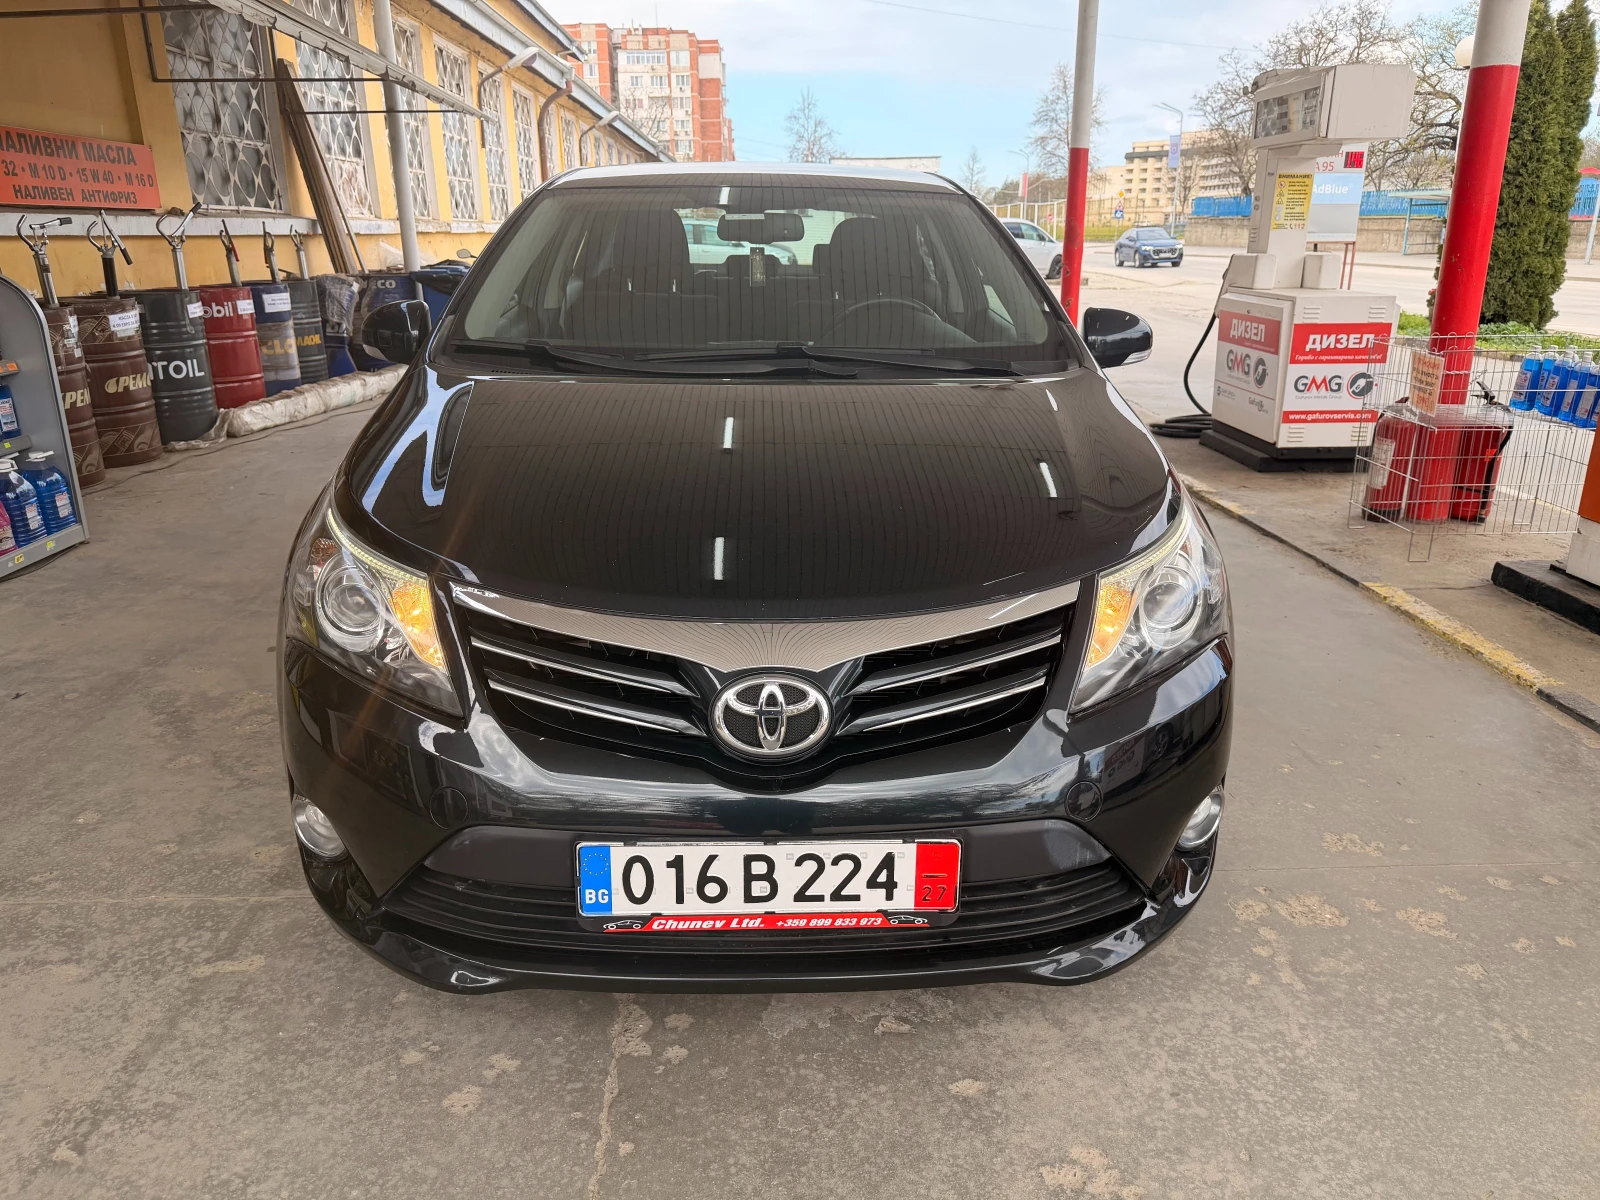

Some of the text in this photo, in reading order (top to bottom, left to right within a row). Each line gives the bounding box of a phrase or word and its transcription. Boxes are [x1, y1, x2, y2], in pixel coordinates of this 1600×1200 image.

[0, 130, 137, 166] АЛИВНИ МАСЛА
[1, 159, 18, 177] 32
[42, 164, 56, 181] 10
[58, 165, 67, 181] D
[76, 167, 89, 184] 15
[89, 168, 100, 184] W
[103, 170, 115, 185] 40
[135, 173, 146, 187] 16
[147, 174, 154, 187] D
[1322, 161, 1335, 172] 95
[12, 184, 138, 204] НАЛИВЕН АНТИФРИЗ
[1313, 183, 1349, 195] AdBlue
[1230, 318, 1265, 342] ДИЗЕЛ
[1305, 333, 1375, 352] ДИЗЕЛ
[1226, 349, 1251, 376] GMG
[1294, 374, 1343, 393] GMG
[1288, 411, 1372, 421] www.gafurovservis.com
[622, 852, 898, 905] 016 B 224
[585, 889, 609, 904] BG
[921, 885, 947, 902] 27
[651, 917, 882, 930] Chunev Ltd. +359 899 833 973
